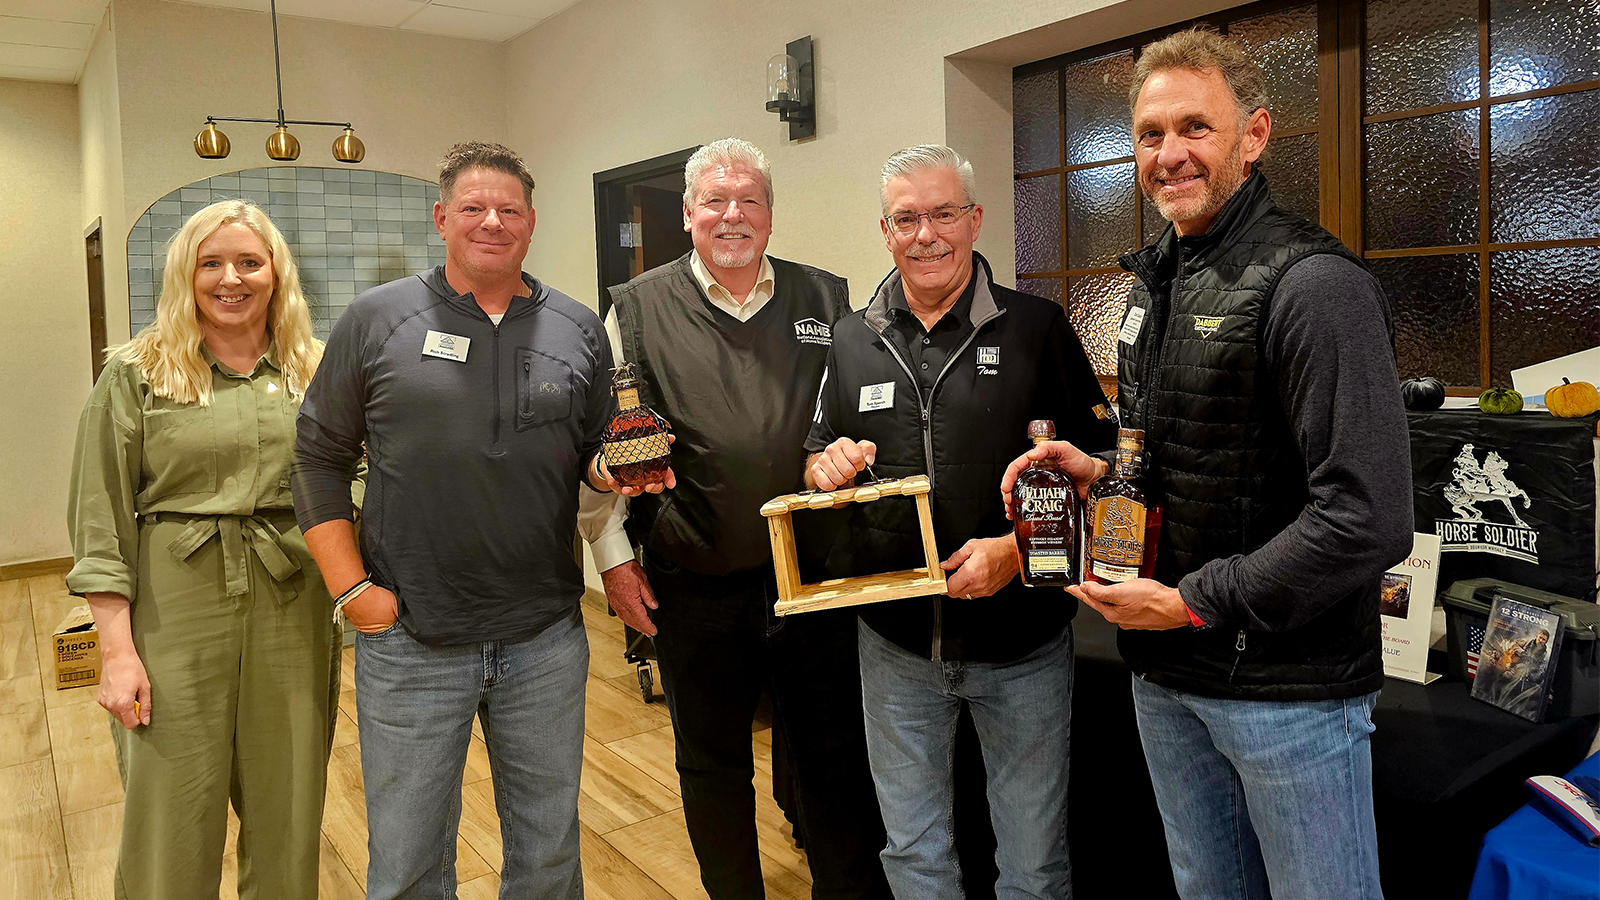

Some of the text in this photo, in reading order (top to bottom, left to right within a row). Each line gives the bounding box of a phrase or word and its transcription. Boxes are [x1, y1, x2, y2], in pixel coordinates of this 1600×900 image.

[794, 323, 831, 337] NAHB
[976, 365, 998, 375] Tom
[1025, 486, 1062, 501] ELIJAH
[1026, 499, 1063, 513] CRAIG
[1435, 521, 1538, 554] HORSE SOLDIER
[1501, 607, 1511, 615] 12
[1511, 610, 1549, 627] STRONG
[57, 641, 96, 653] 918CD
[1391, 637, 1411, 645] BOARD
